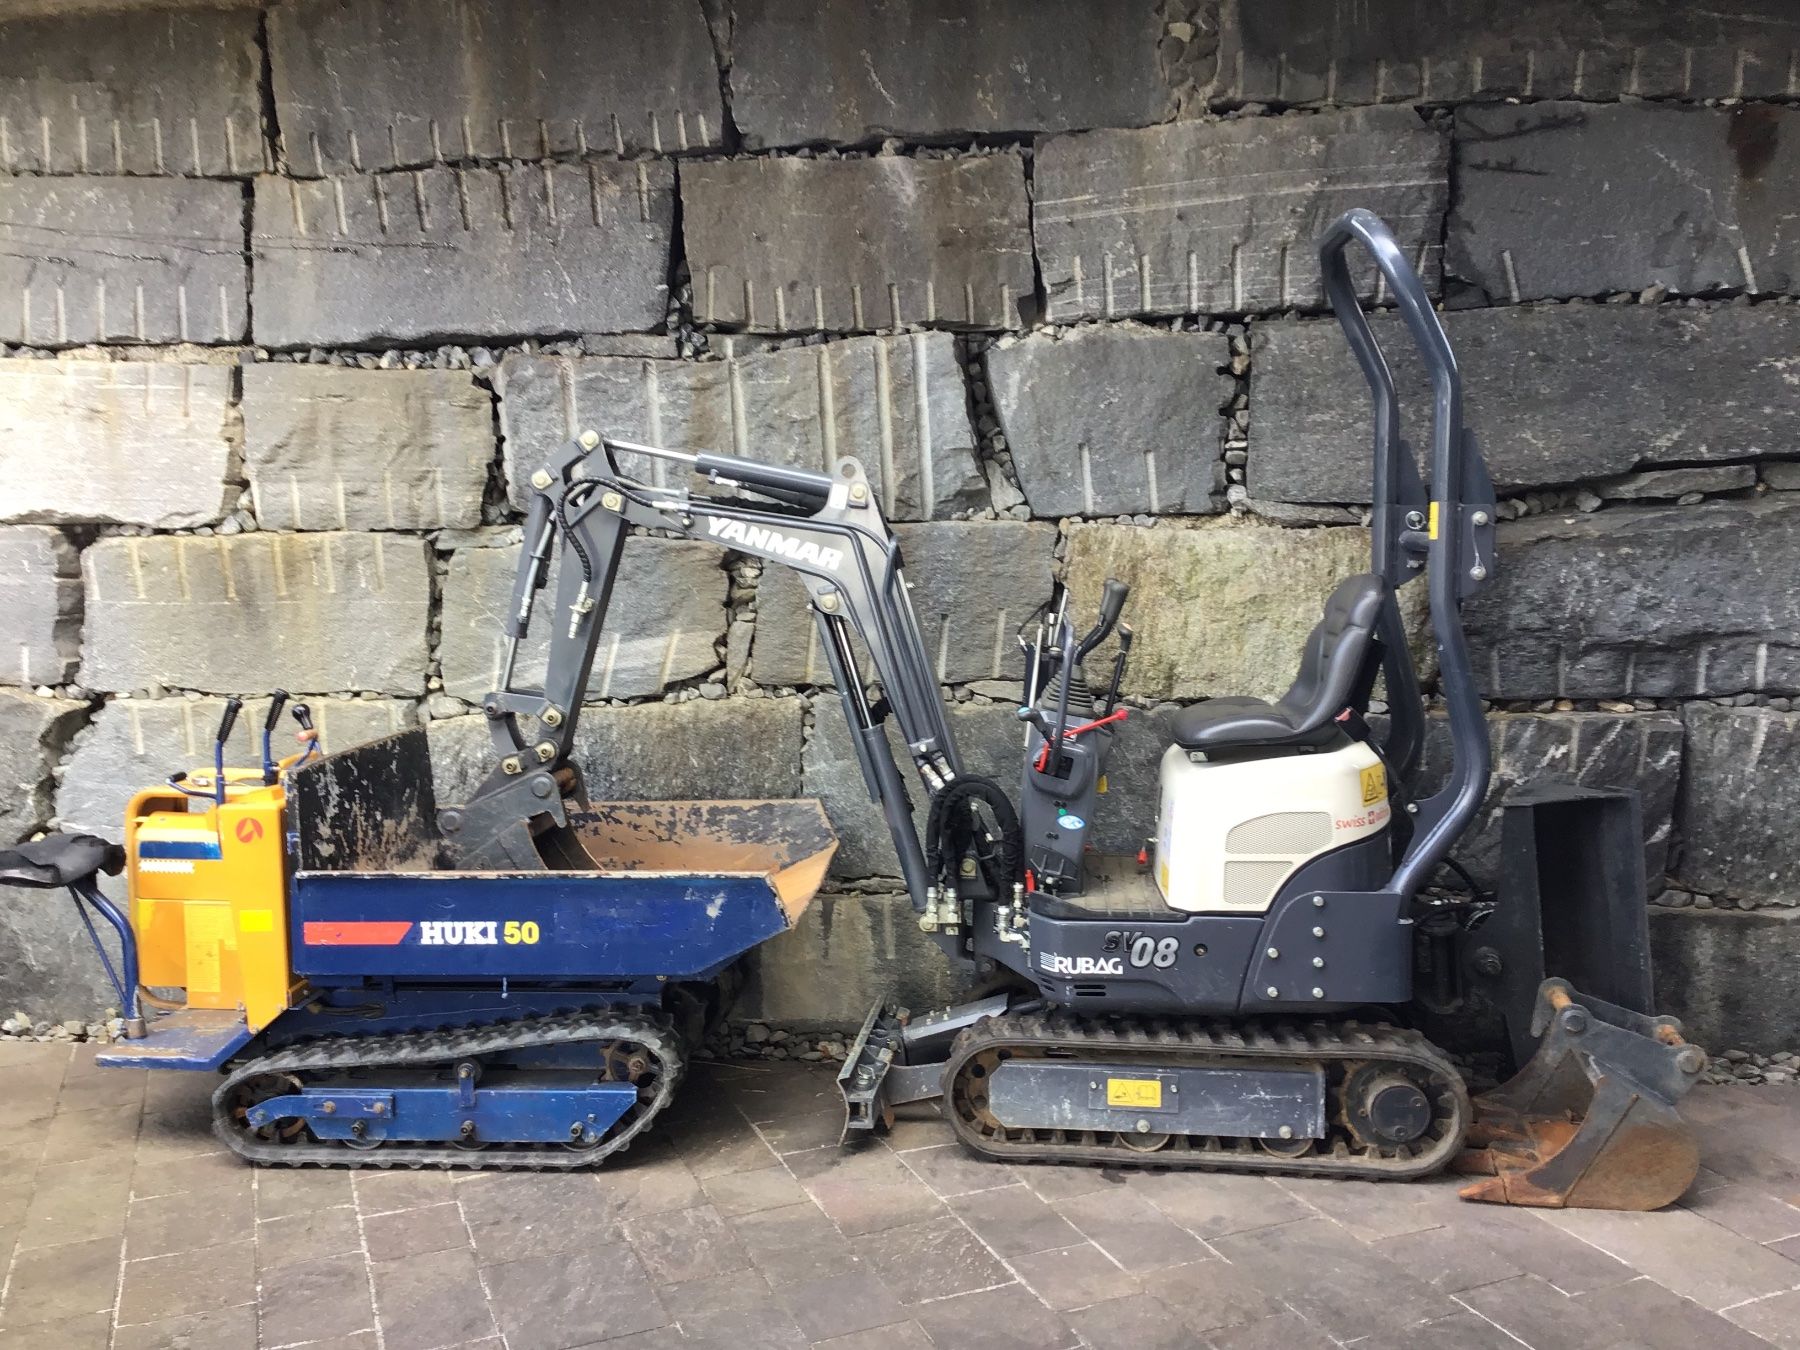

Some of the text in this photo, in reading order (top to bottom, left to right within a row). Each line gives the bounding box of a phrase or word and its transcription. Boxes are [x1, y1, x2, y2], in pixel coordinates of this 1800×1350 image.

[708, 516, 843, 570] YANMAR
[420, 921, 540, 945] HUKI 50
